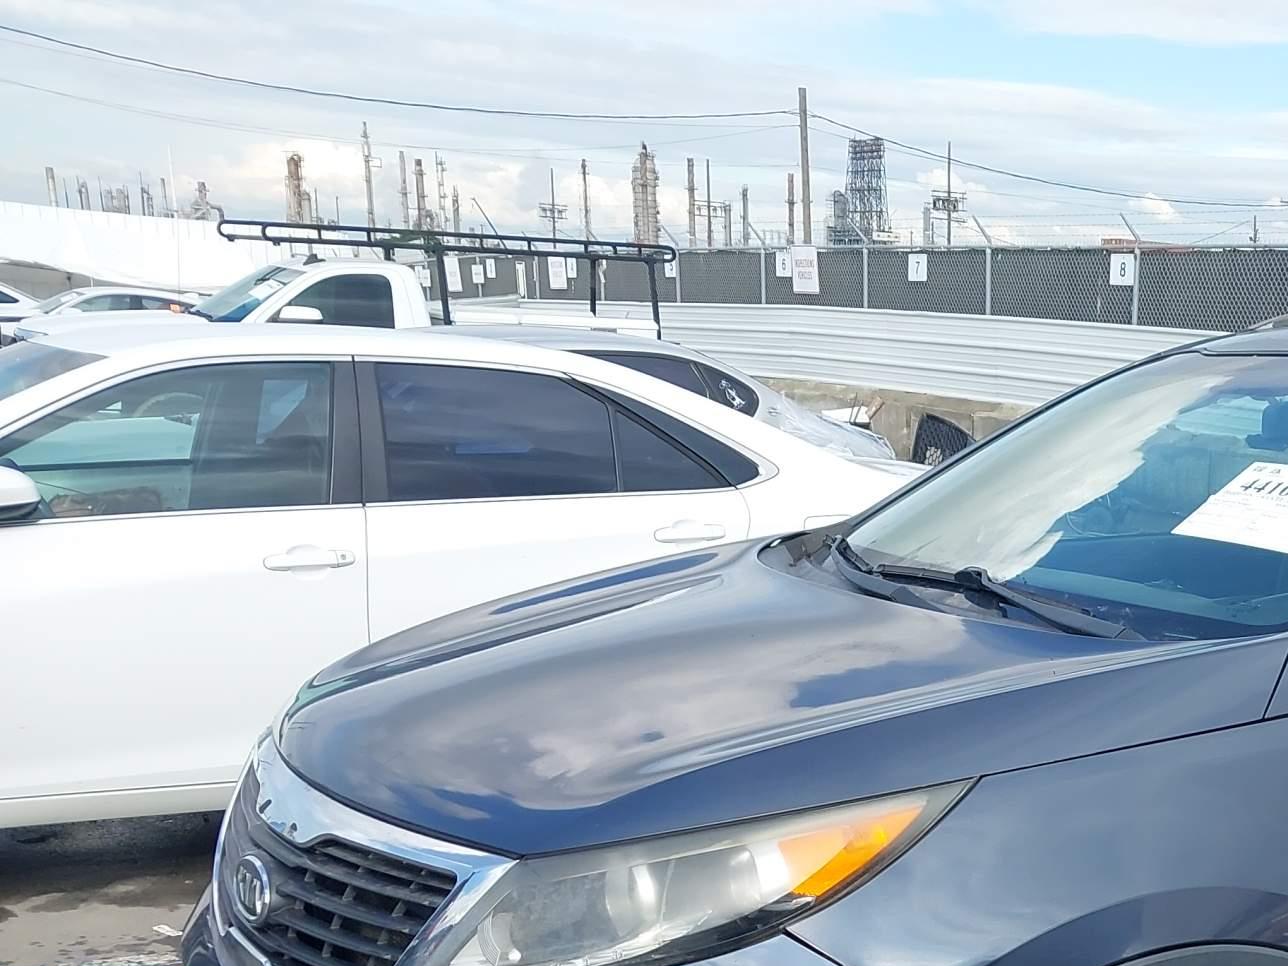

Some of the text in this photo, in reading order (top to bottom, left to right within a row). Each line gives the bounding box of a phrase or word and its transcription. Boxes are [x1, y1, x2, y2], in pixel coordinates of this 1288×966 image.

[781, 258, 787, 271] 6
[915, 260, 921, 275] 7
[1119, 262, 1126, 278] 8
